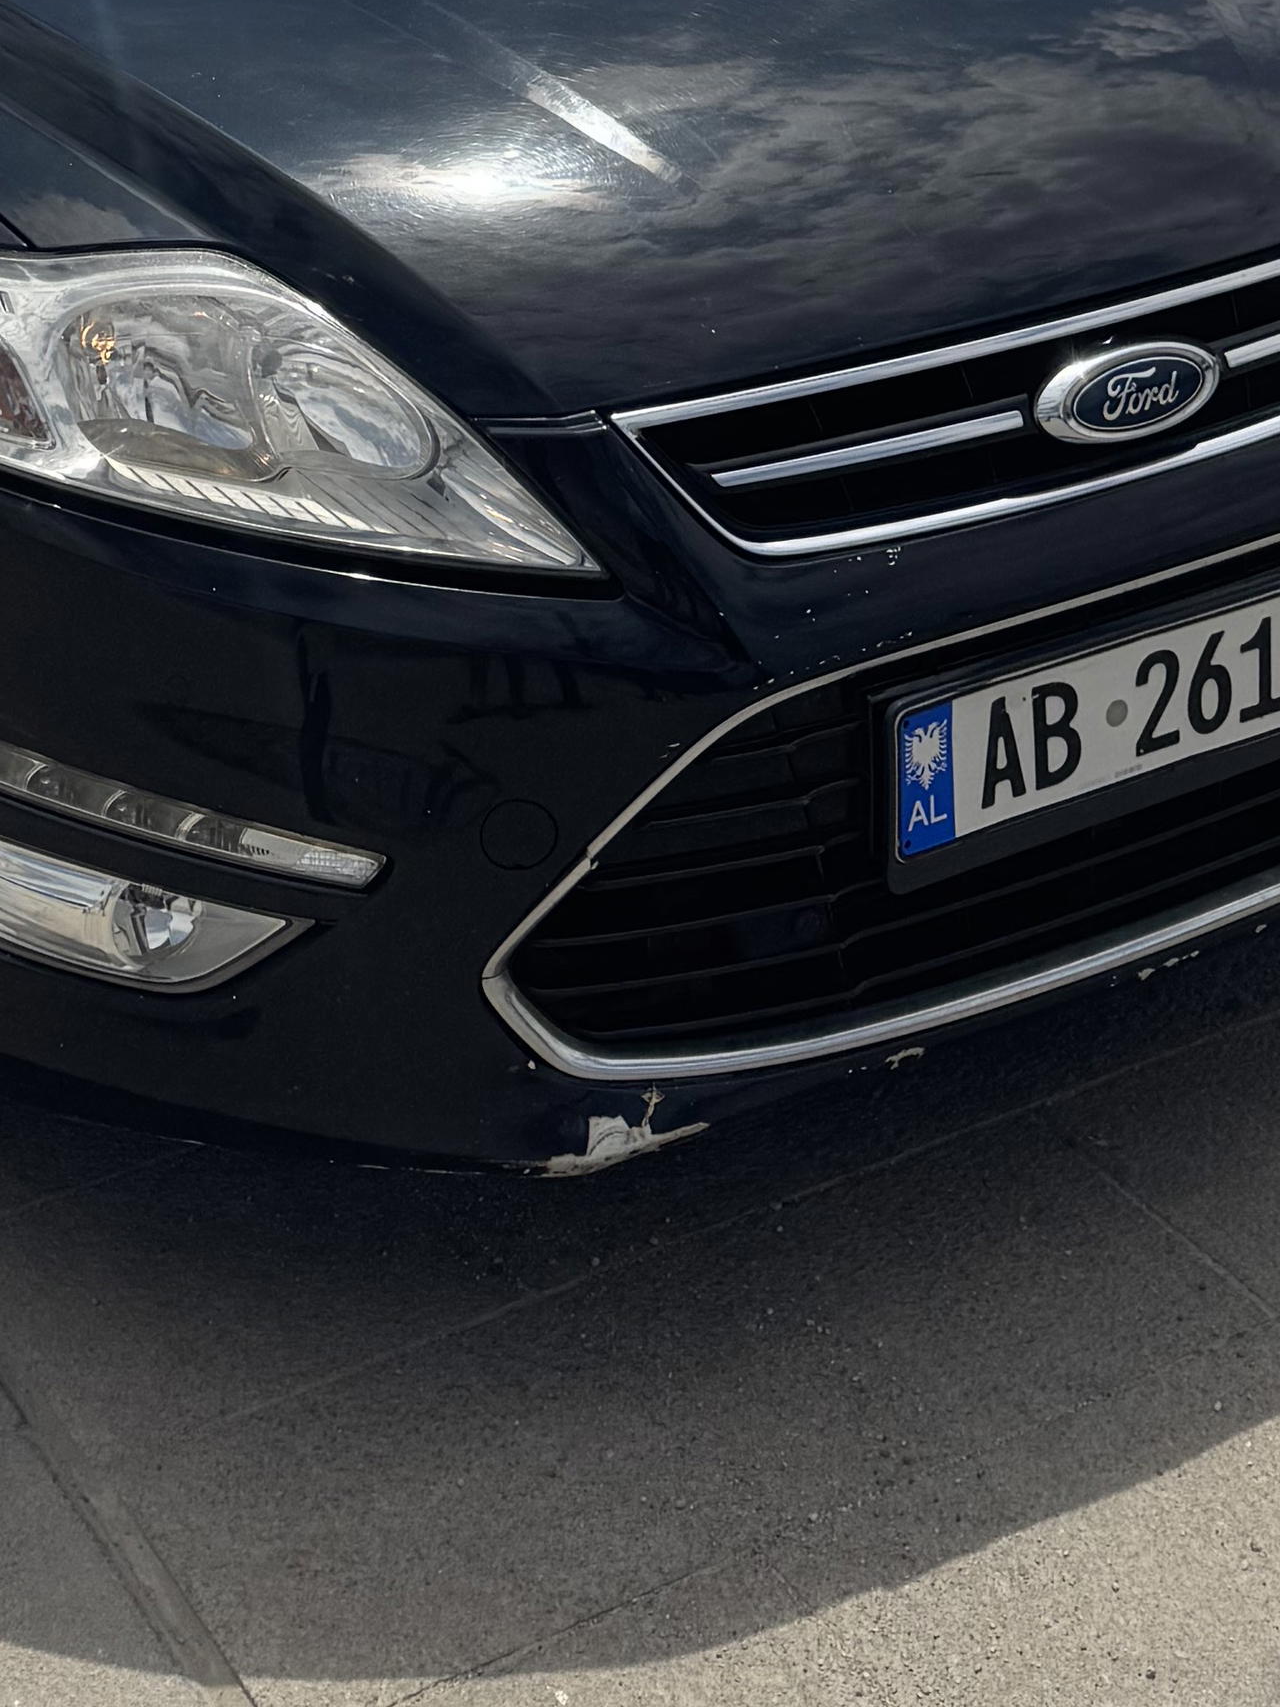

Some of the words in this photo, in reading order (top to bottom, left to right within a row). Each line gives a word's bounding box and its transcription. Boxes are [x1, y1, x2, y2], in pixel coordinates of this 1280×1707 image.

[1102, 366, 1180, 421] Ford
[981, 681, 1082, 809] AB
[907, 794, 948, 833] AL
